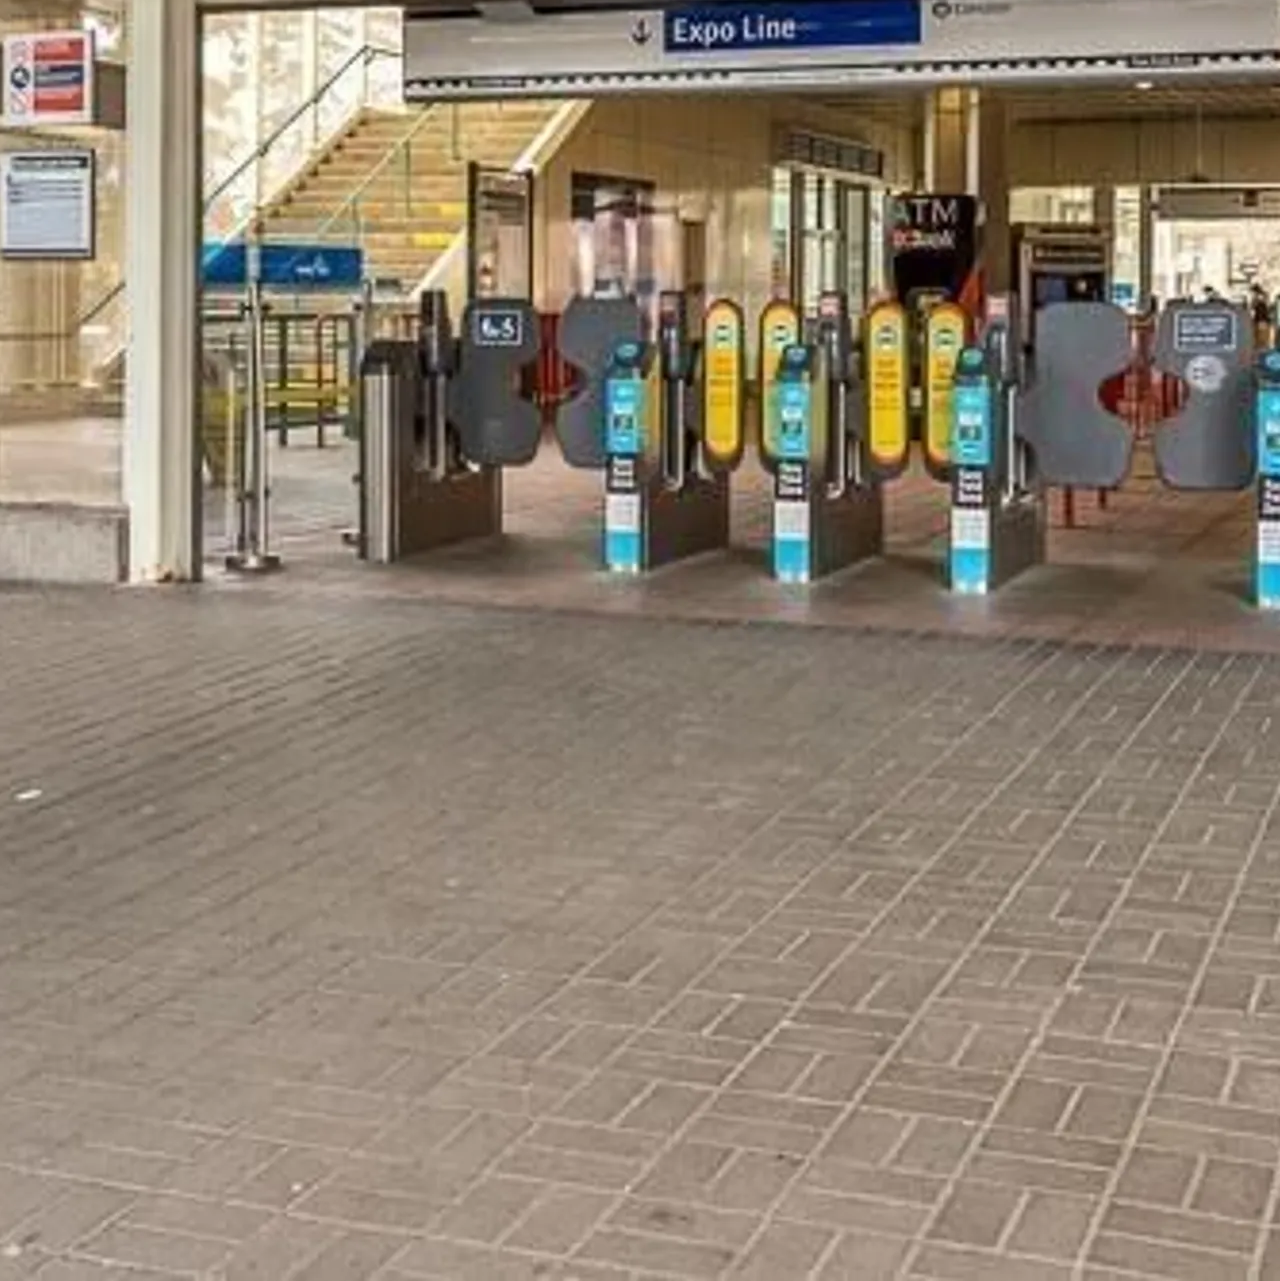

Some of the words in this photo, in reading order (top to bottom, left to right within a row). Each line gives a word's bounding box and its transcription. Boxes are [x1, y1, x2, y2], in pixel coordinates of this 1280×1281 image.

[673, 17, 736, 48] Expo
[743, 14, 796, 40] Line
[888, 198, 957, 224] ATM
